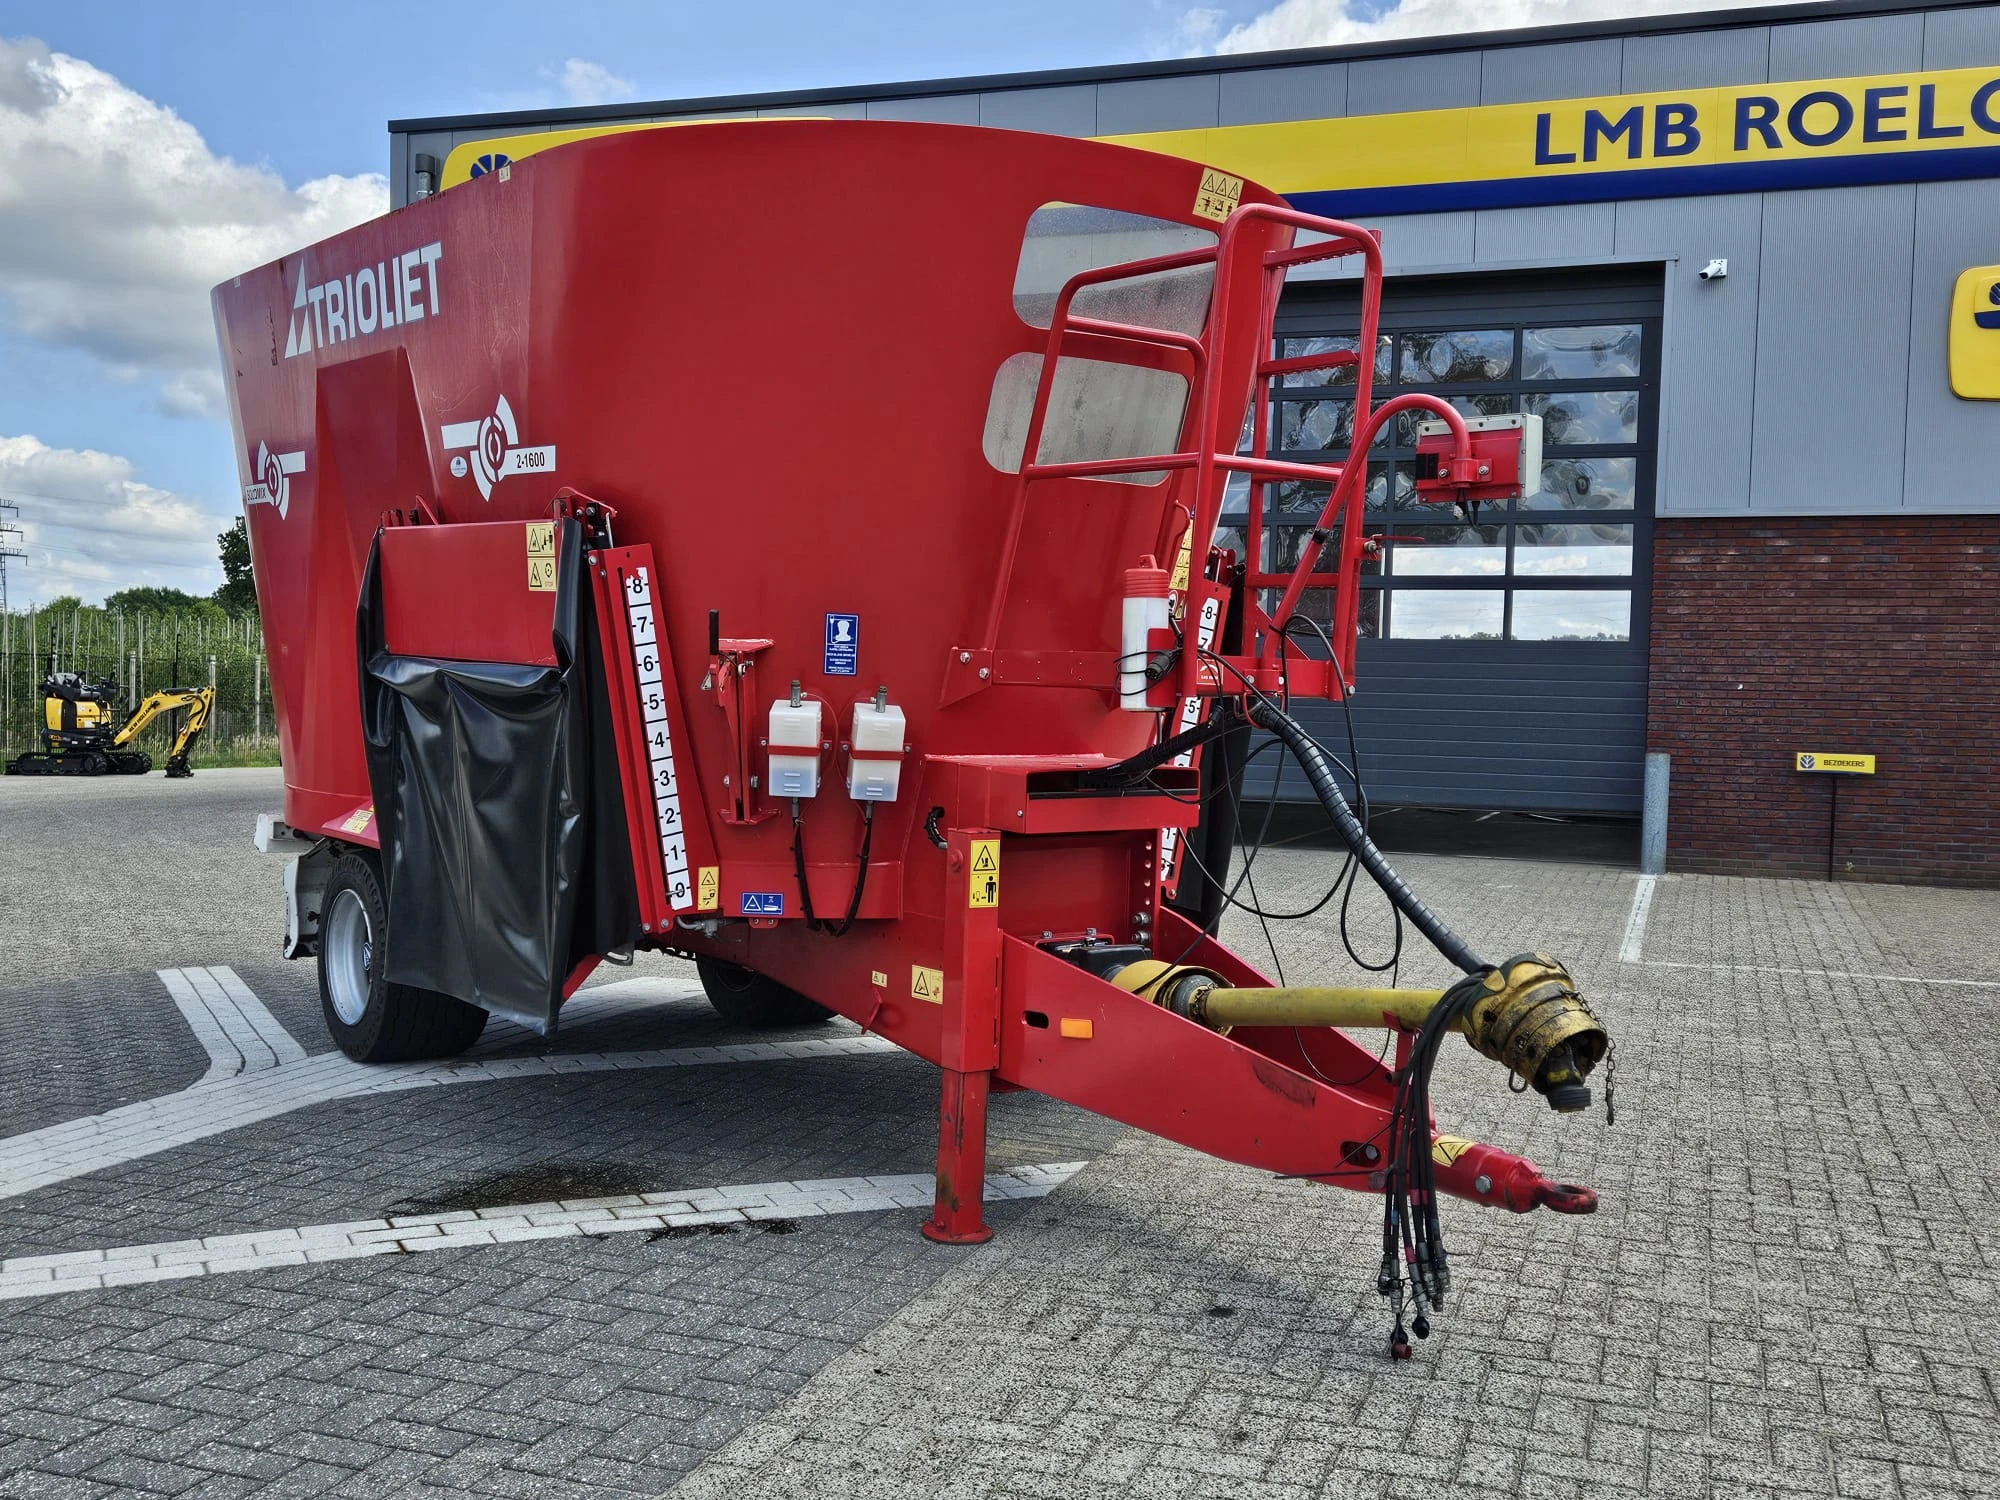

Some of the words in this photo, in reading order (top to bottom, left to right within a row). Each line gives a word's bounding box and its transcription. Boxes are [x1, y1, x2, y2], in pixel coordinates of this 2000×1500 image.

[1535, 103, 1701, 166] LMB
[307, 240, 442, 349] TRIOLIET
[516, 452, 545, 469] 2-1600
[1823, 759, 1865, 768] BEZOEKERS
